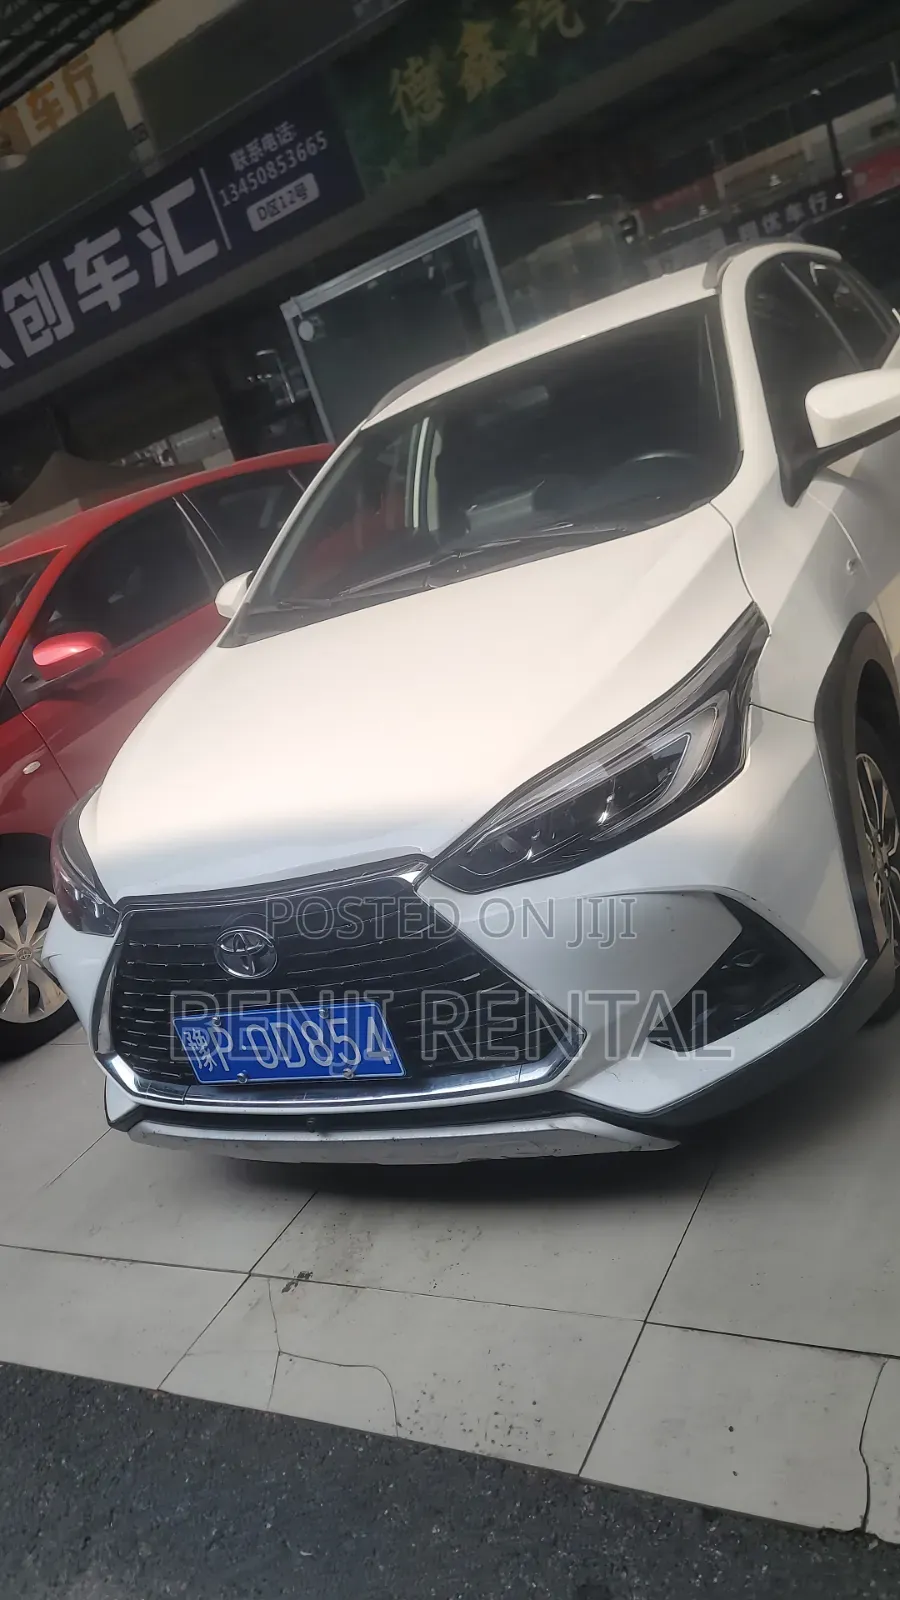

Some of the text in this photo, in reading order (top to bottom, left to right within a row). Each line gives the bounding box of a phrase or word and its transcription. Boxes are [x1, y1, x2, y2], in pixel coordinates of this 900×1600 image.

[219, 130, 328, 207] 13450853665
[256, 182, 308, 222] D区12号
[0, 177, 218, 369] 创车汇
